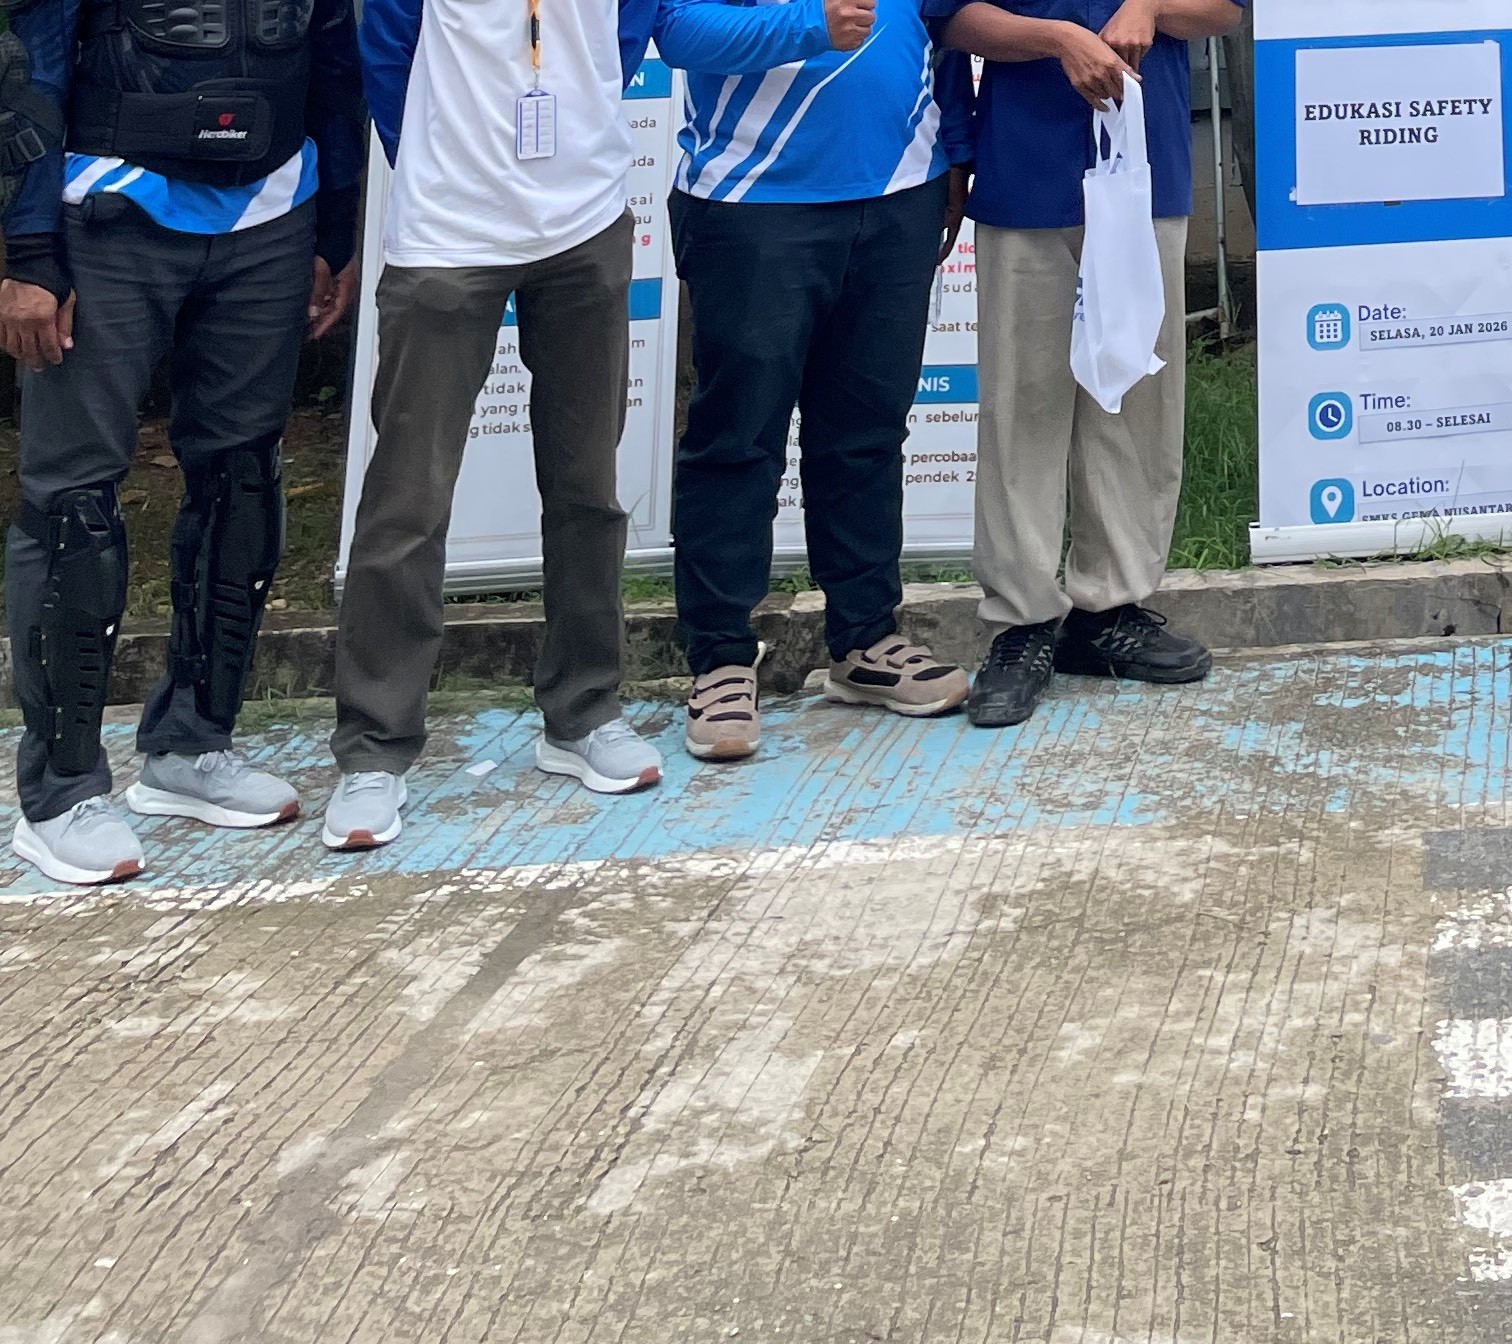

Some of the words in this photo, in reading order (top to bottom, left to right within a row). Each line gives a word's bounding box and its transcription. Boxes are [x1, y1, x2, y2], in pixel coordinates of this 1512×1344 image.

[1304, 101, 1401, 120] EDUKASI
[1409, 98, 1493, 118] SAFETY
[629, 117, 657, 129] ada
[1359, 127, 1439, 145] RIDING
[1358, 305, 1407, 322] Date:
[1370, 327, 1425, 342] SELASA,
[1429, 325, 1444, 337] 20
[1448, 323, 1474, 336] JAN
[1477, 321, 1508, 333] 2026
[483, 382, 526, 394] tidak
[917, 376, 950, 392] NIS
[1359, 393, 1411, 410] Time:
[480, 403, 518, 418] yang
[482, 422, 520, 434] tidak
[1386, 419, 1422, 433] 08.30
[1436, 413, 1491, 428] SELESAI
[911, 451, 977, 466] percobaa
[906, 471, 960, 486] pendek
[1362, 477, 1450, 497] Location:
